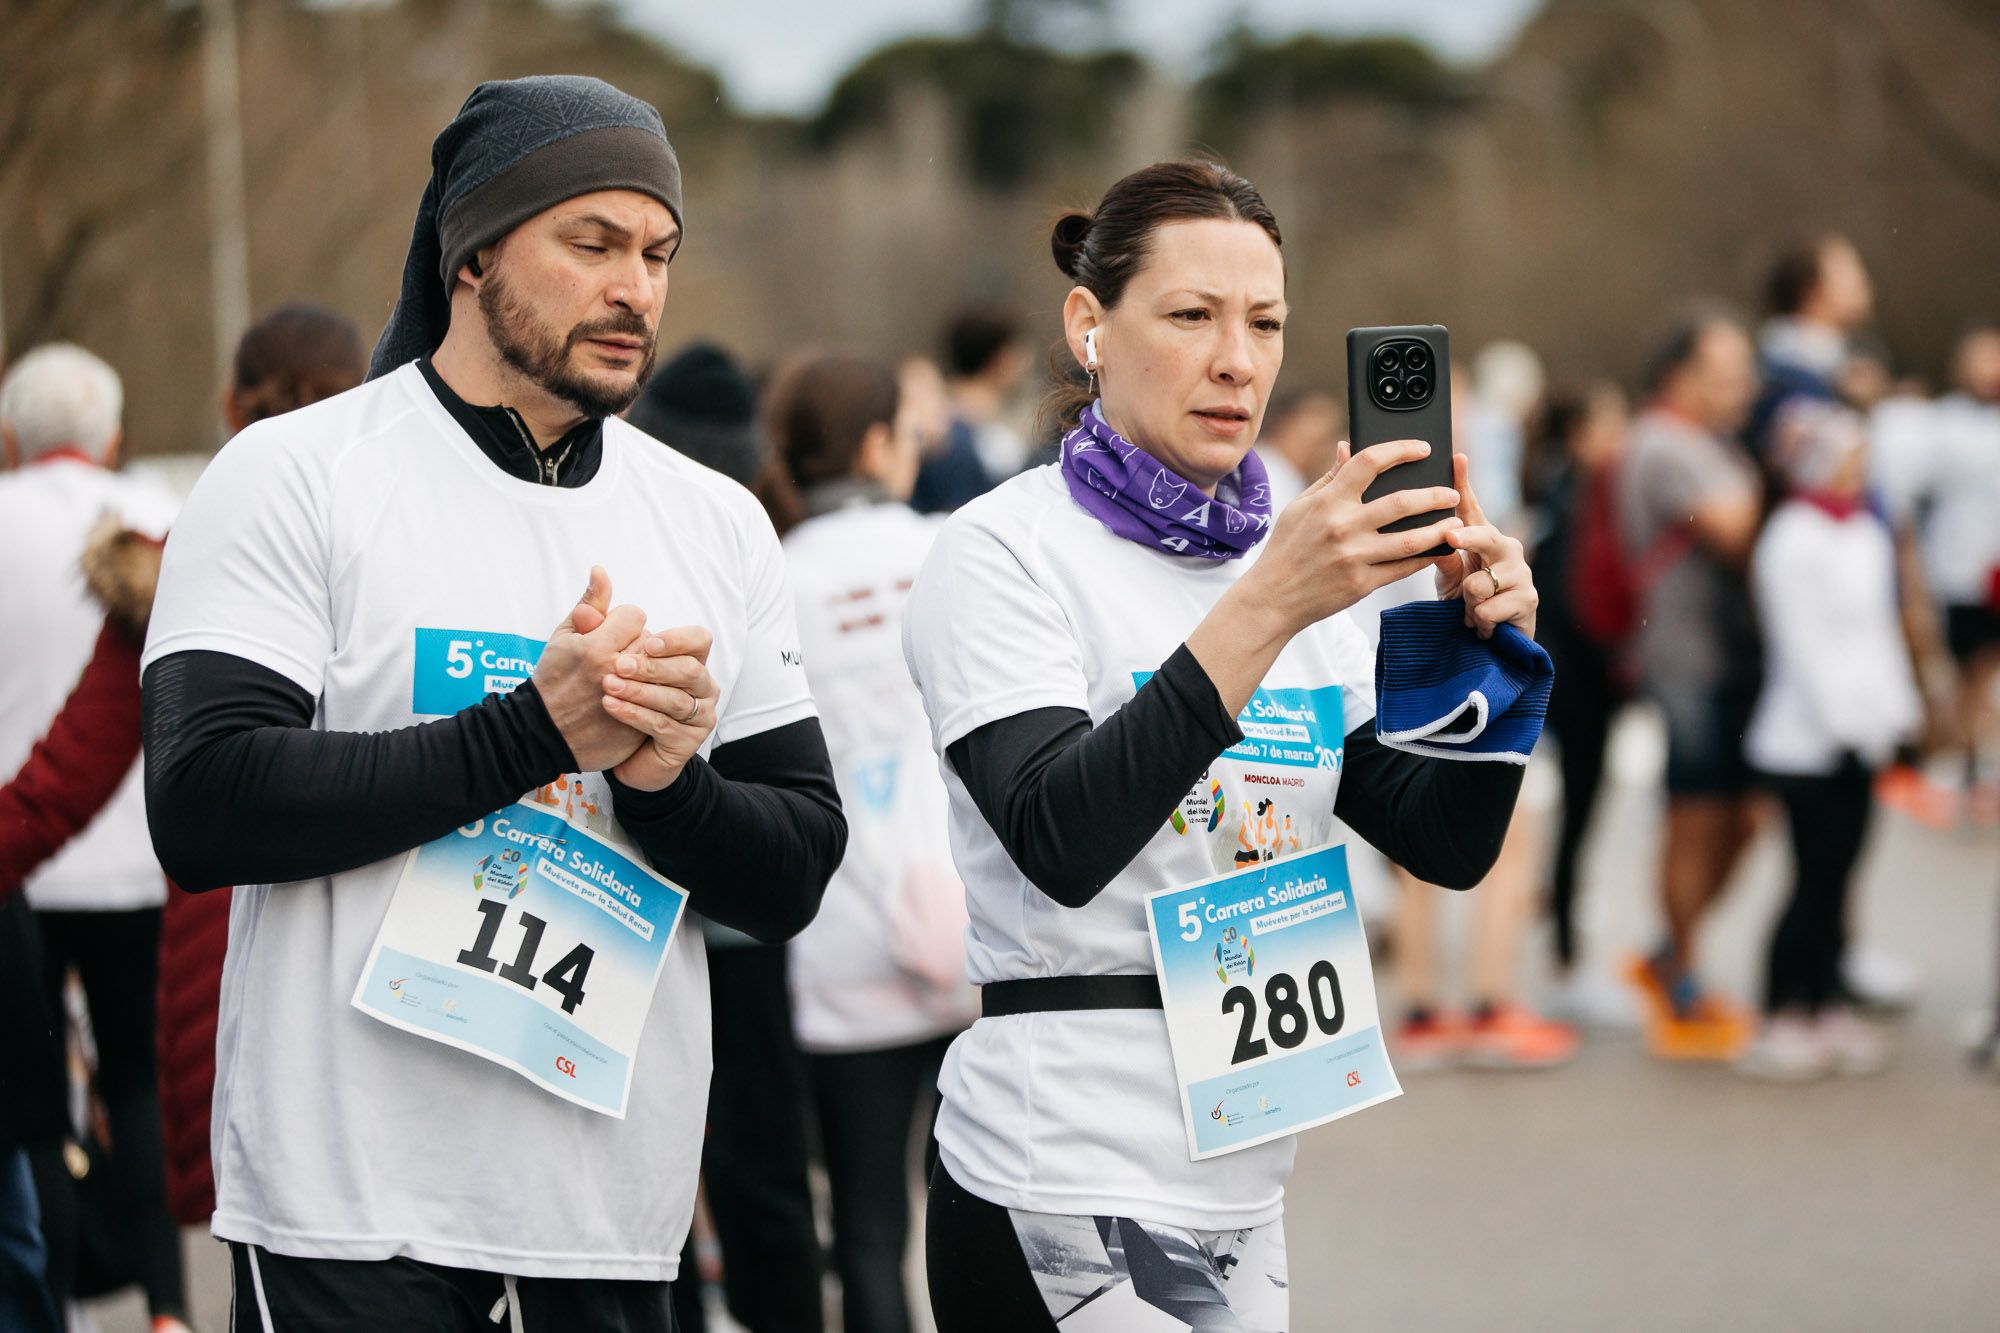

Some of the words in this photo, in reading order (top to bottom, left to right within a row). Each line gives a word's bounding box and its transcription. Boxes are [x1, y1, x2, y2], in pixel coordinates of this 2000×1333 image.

[480, 649, 537, 675] Carre
[1261, 745, 1268, 757] 7
[1270, 744, 1283, 758] de
[1284, 749, 1315, 762] marzo
[1244, 773, 1281, 786] MONCLOA
[492, 818, 567, 862] Carrera
[569, 851, 642, 908] Solidaria
[543, 863, 580, 890] Muévete
[580, 886, 596, 900] por
[598, 890, 607, 905] la
[607, 900, 628, 920] Salud
[629, 914, 650, 935] Renal
[1205, 896, 1266, 924] Carrera
[1267, 874, 1328, 907] Solidaria
[1256, 915, 1289, 930] Muévete
[1289, 910, 1302, 921] por
[1302, 908, 1310, 916] la
[1310, 901, 1327, 914] Salud
[1327, 897, 1343, 908] Renal
[456, 898, 595, 1016] 114
[1221, 959, 1345, 1066] 280
[555, 1055, 577, 1080] CSL
[1346, 1070, 1362, 1088] CSL
